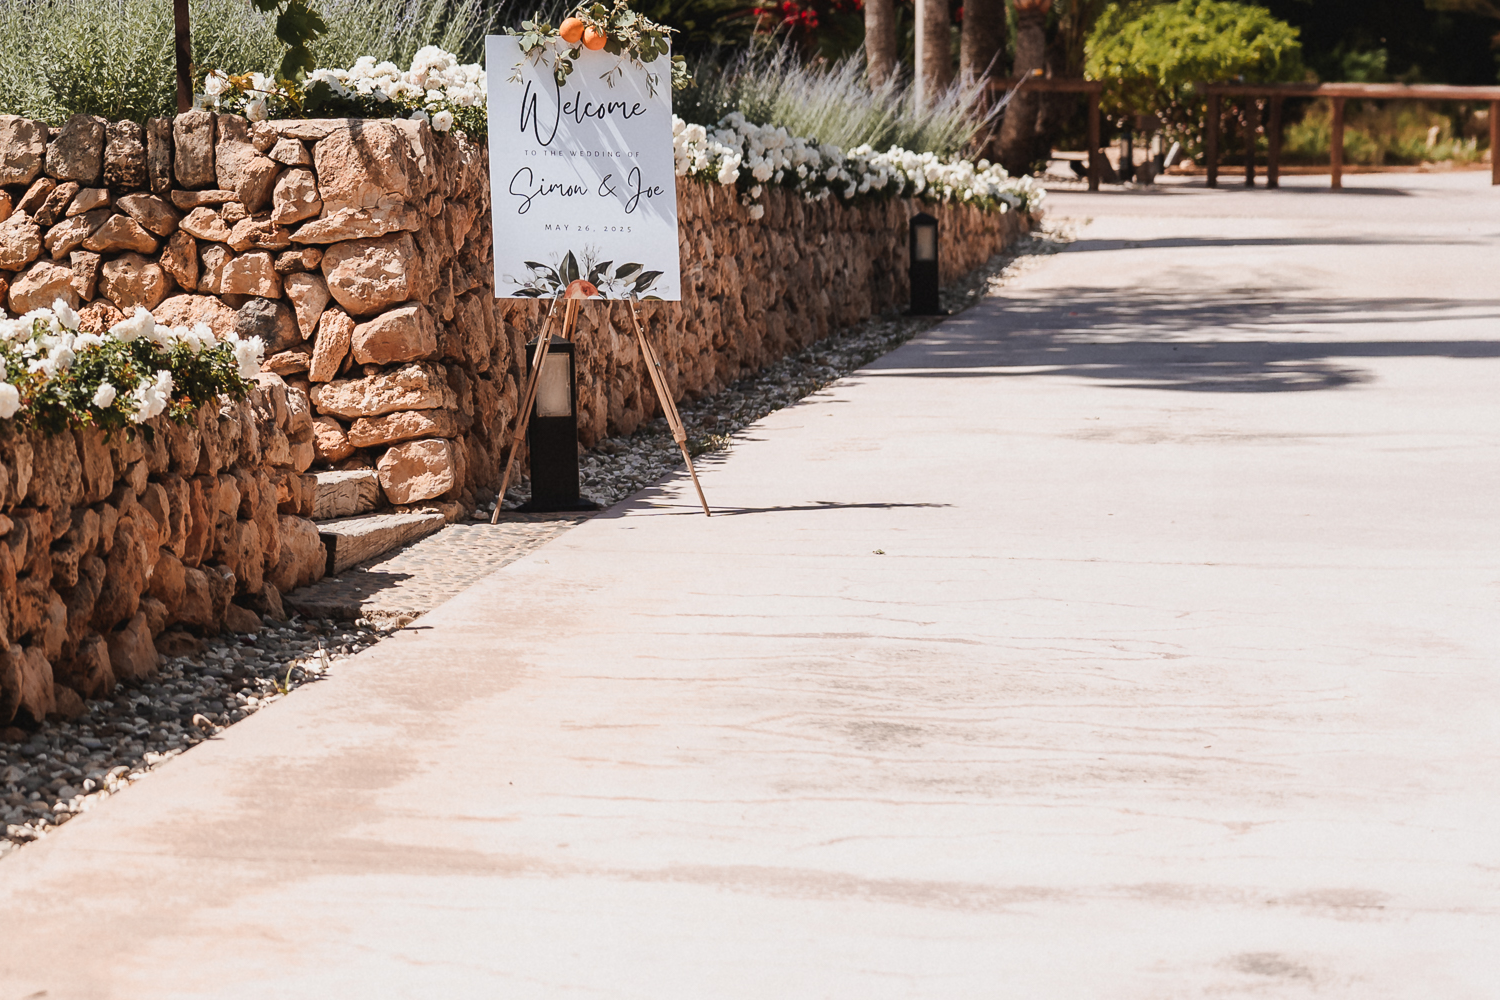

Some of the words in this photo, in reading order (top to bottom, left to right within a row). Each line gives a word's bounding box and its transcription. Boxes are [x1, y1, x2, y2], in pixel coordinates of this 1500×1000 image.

[520, 71, 647, 147] Welcome
[524, 149, 537, 157] TO
[544, 149, 564, 157] THE
[569, 149, 621, 158] WEDDING
[509, 166, 588, 214] Simon
[598, 173, 618, 197] &
[624, 166, 665, 214] Joe
[544, 223, 570, 232] MAY
